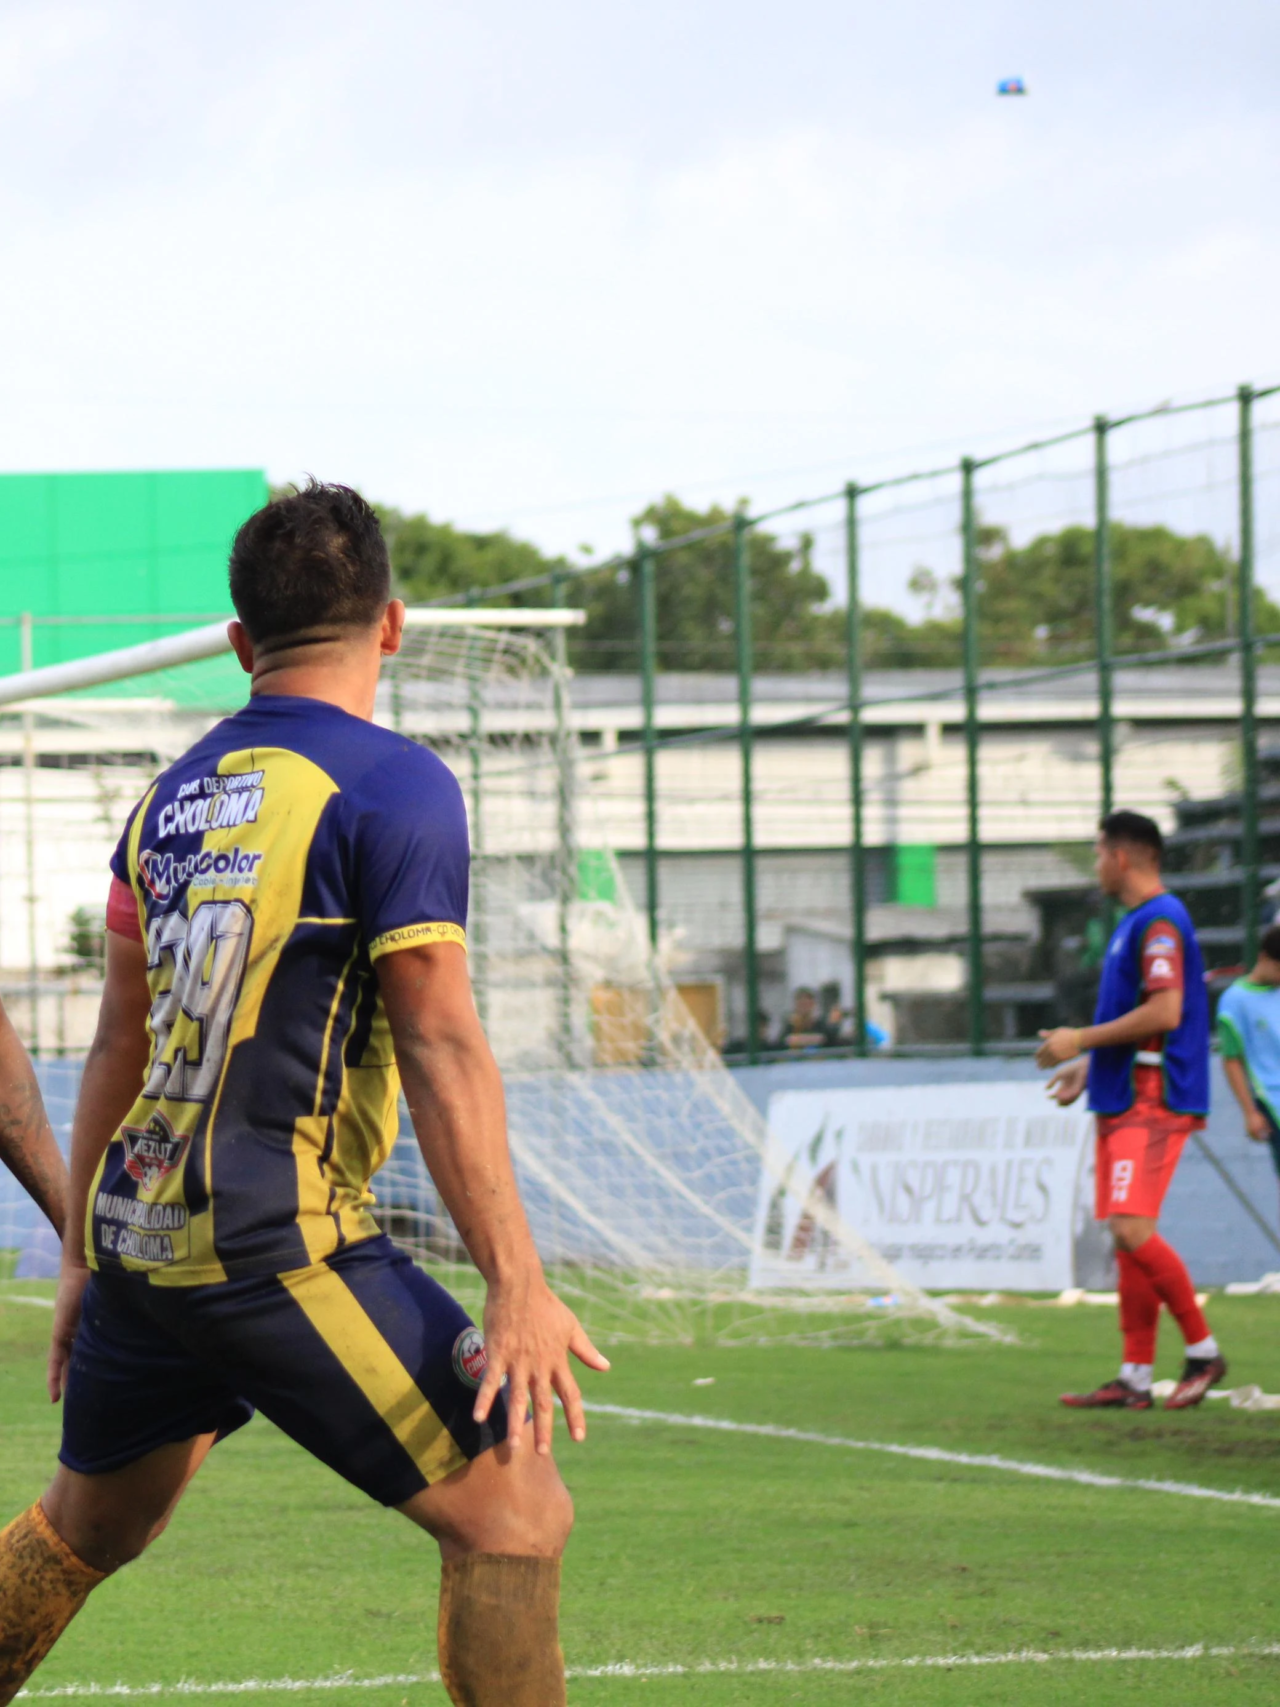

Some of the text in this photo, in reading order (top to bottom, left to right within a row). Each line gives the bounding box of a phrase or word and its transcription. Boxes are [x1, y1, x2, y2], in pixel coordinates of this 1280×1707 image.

[158, 788, 265, 838] CHOLOMA
[101, 1223, 175, 1261] DE CHOLOMA
